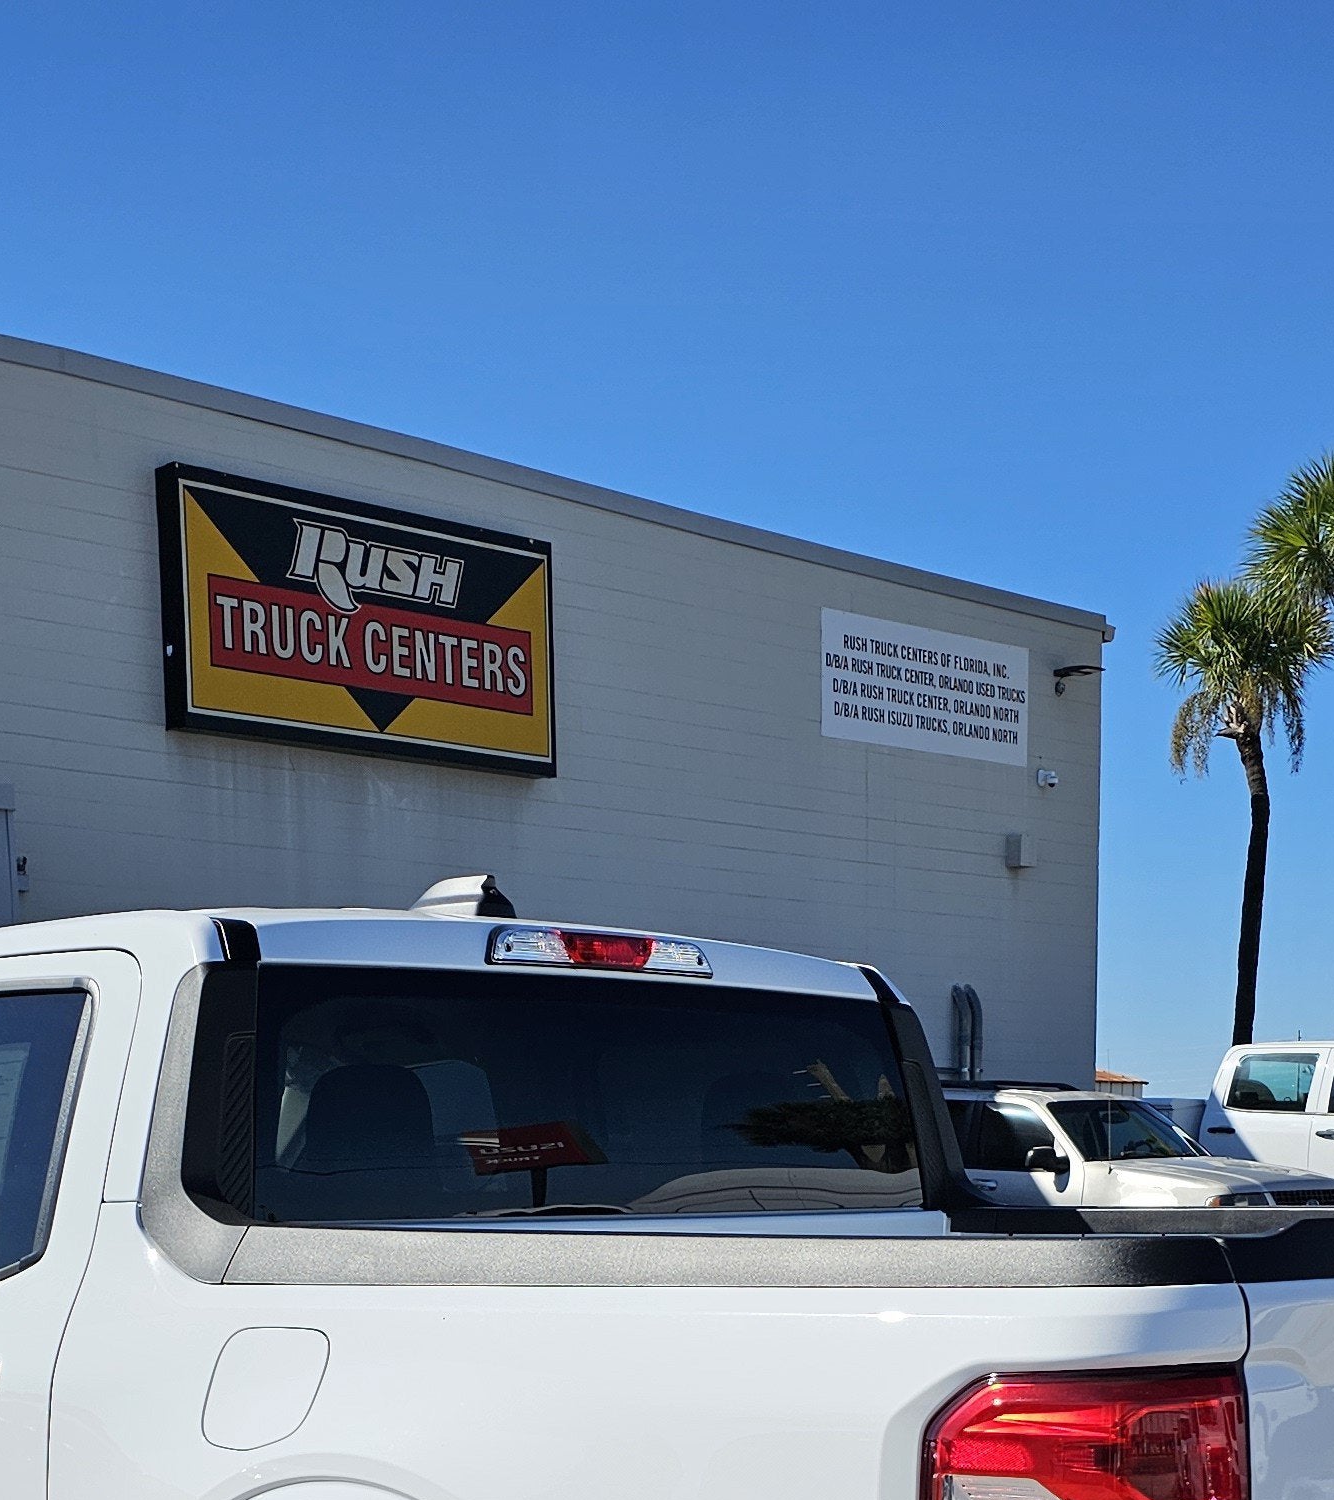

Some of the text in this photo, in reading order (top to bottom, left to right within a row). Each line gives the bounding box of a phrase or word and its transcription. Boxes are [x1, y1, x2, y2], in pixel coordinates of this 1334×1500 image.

[216, 595, 527, 696] TRUCK CENTERS
[844, 634, 1009, 679] RUSH TRUCK CENTERS OF FLORIDA, INC.
[825, 652, 1025, 703] D/B/A RUSH TRUCK CENTER, ORLANDO USED TRUCKS
[832, 678, 1019, 724] D/B/A RUSH TRUCK CENTER, ORLANDO NORTH
[834, 701, 1018, 745] D/B/A RUSH ISUZU TRUCKS, ORLANDO NORTH
